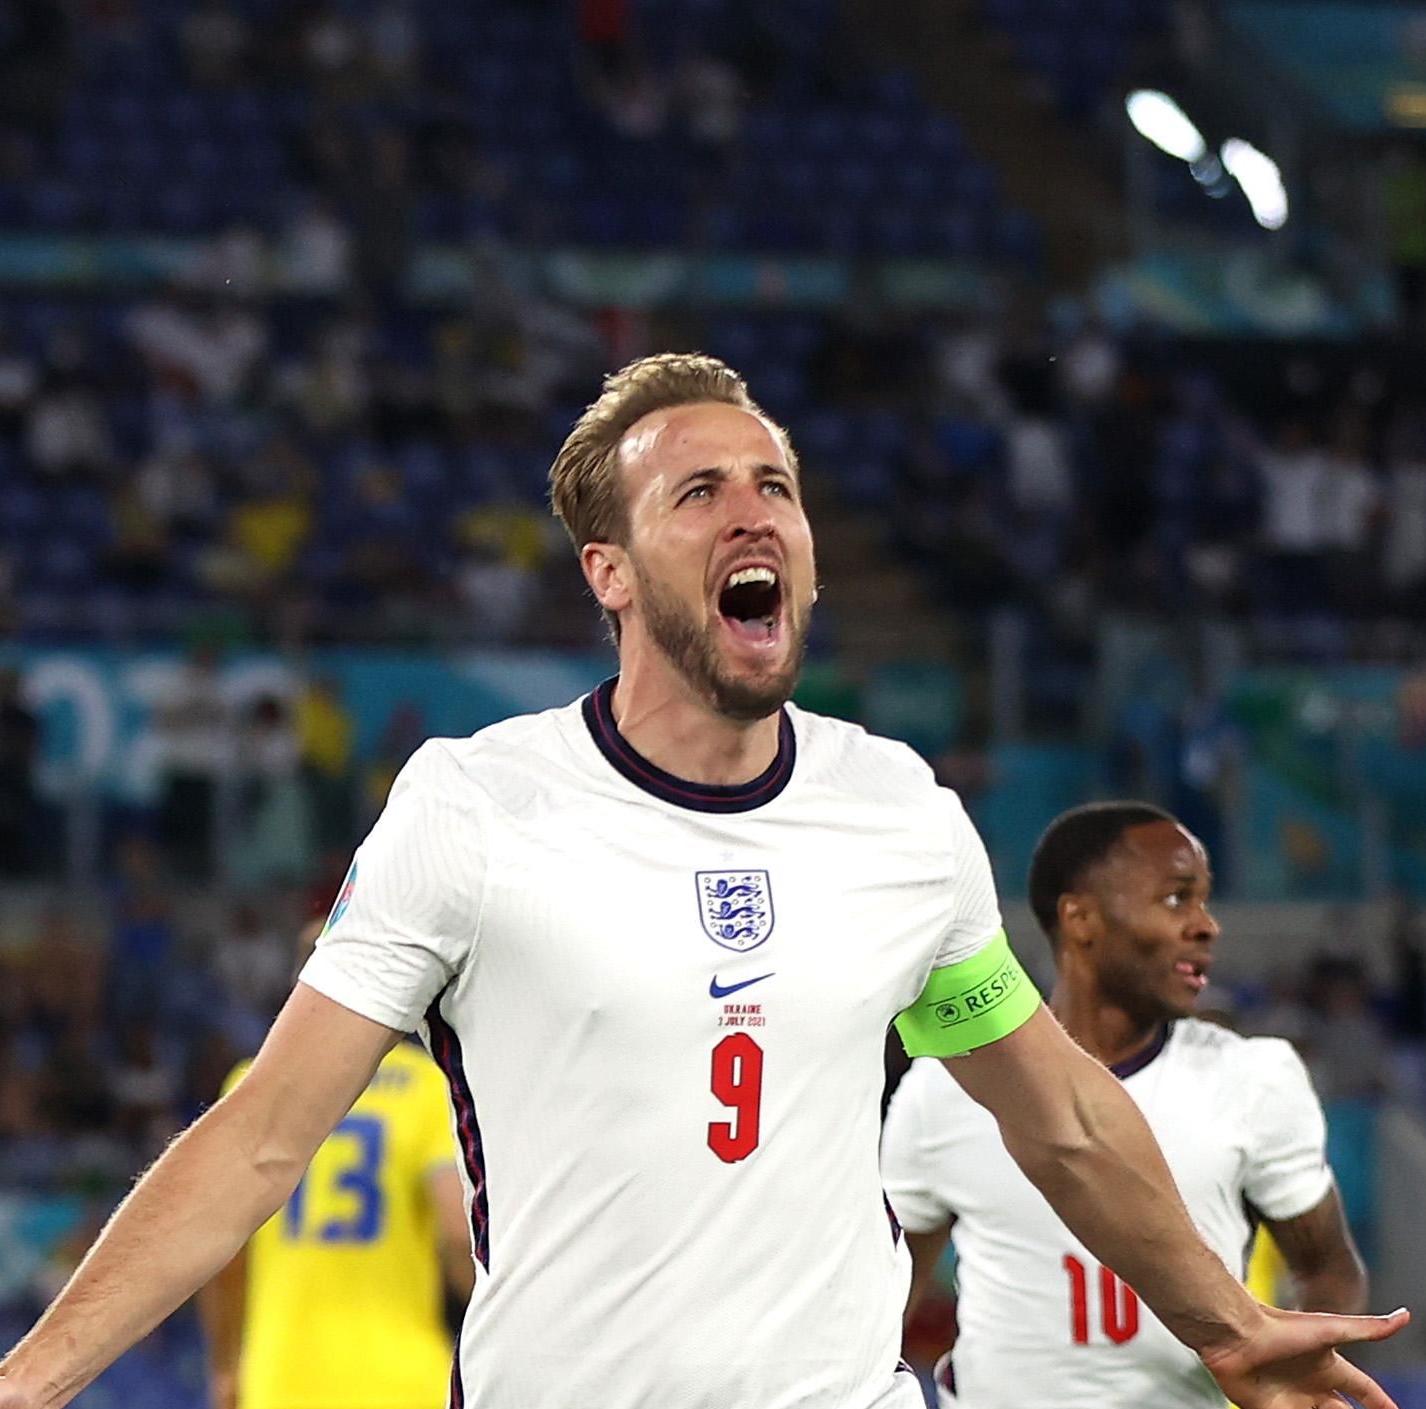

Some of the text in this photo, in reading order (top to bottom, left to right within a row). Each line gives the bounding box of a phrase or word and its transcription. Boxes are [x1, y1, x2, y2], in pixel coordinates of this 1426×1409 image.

[724, 1005, 761, 1014] UKRAINE
[965, 964, 1019, 1012] RESPE
[725, 1017, 745, 1026] JULY
[748, 1017, 766, 1026] 2021
[707, 1032, 764, 1164] 9
[1063, 1254, 1139, 1345] 10
